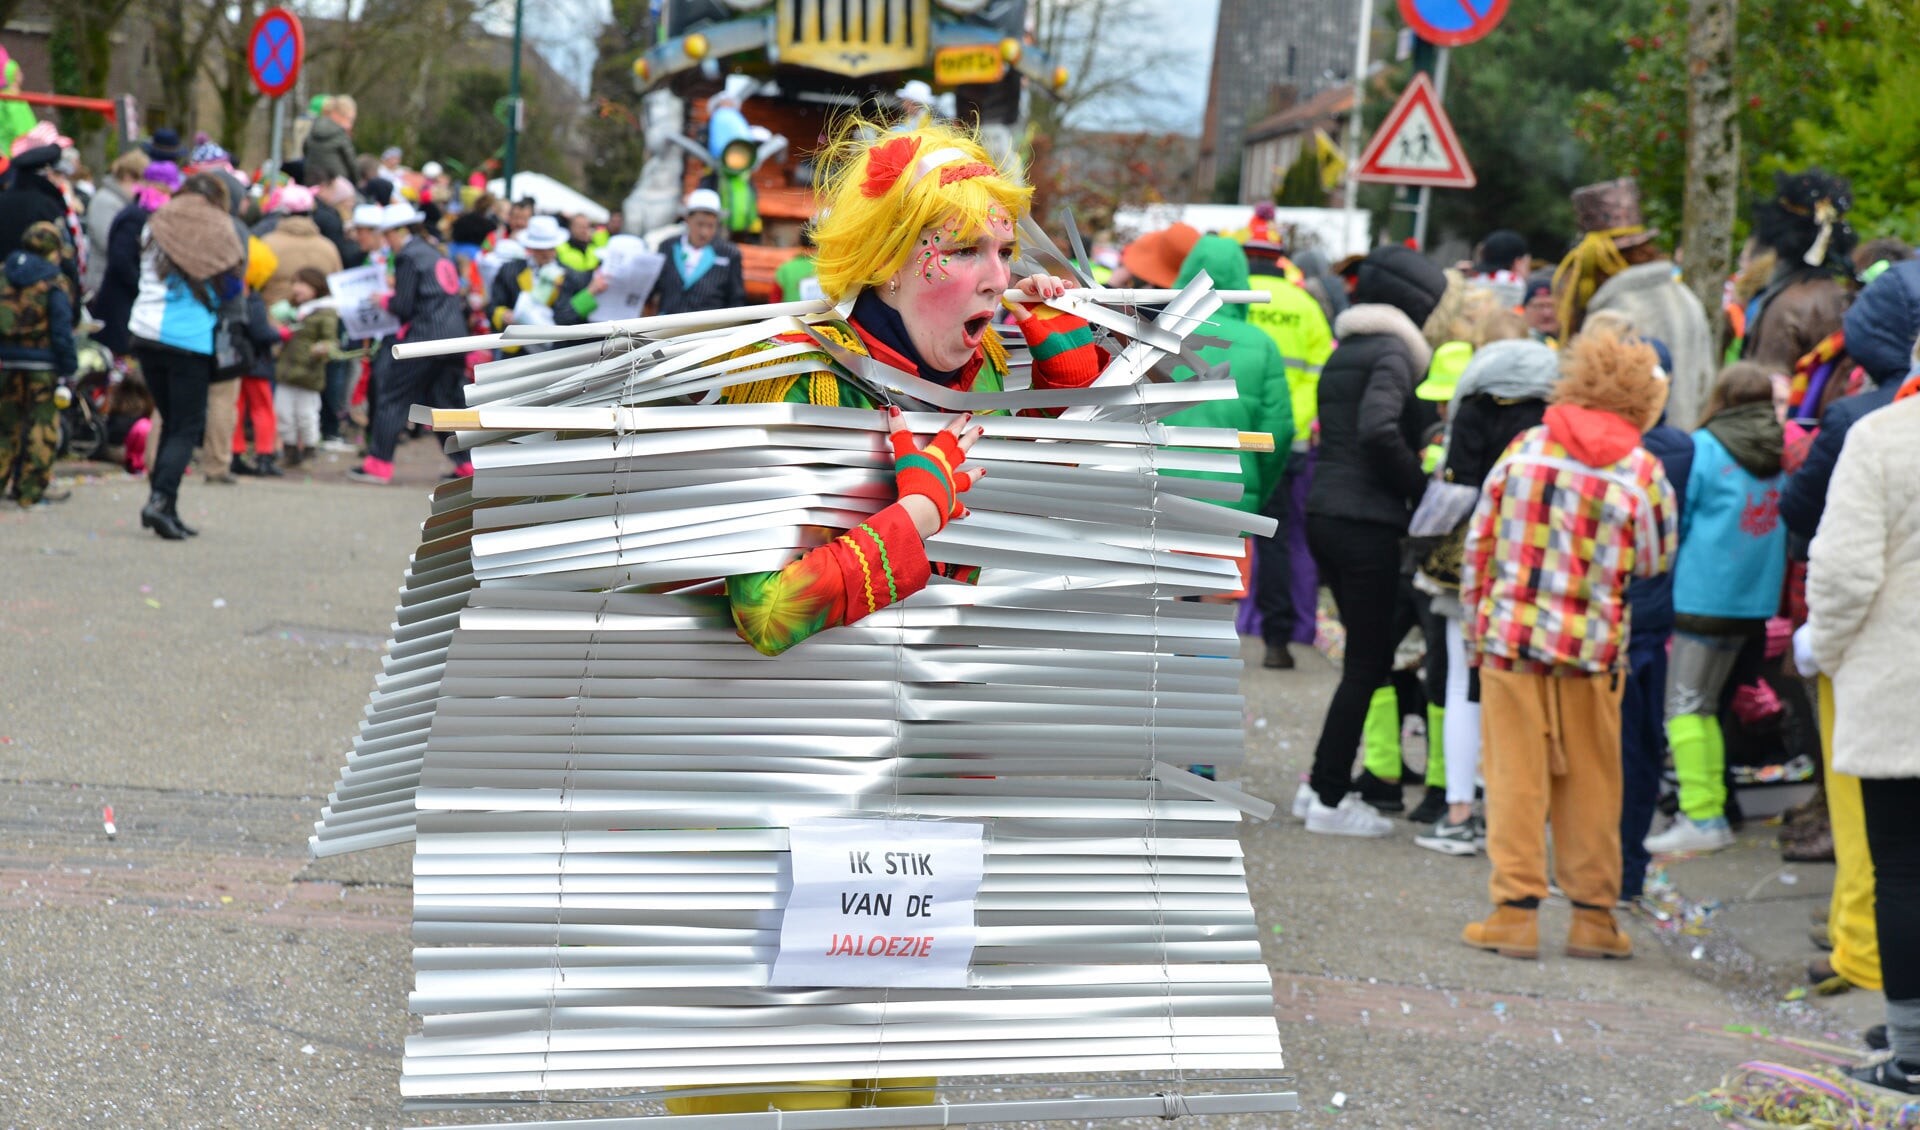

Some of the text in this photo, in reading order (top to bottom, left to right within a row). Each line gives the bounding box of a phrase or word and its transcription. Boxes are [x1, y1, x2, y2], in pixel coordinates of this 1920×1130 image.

[849, 851, 934, 876] IK STIK
[841, 892, 934, 917] VAN DE
[825, 934, 934, 958] JALOEZIE
